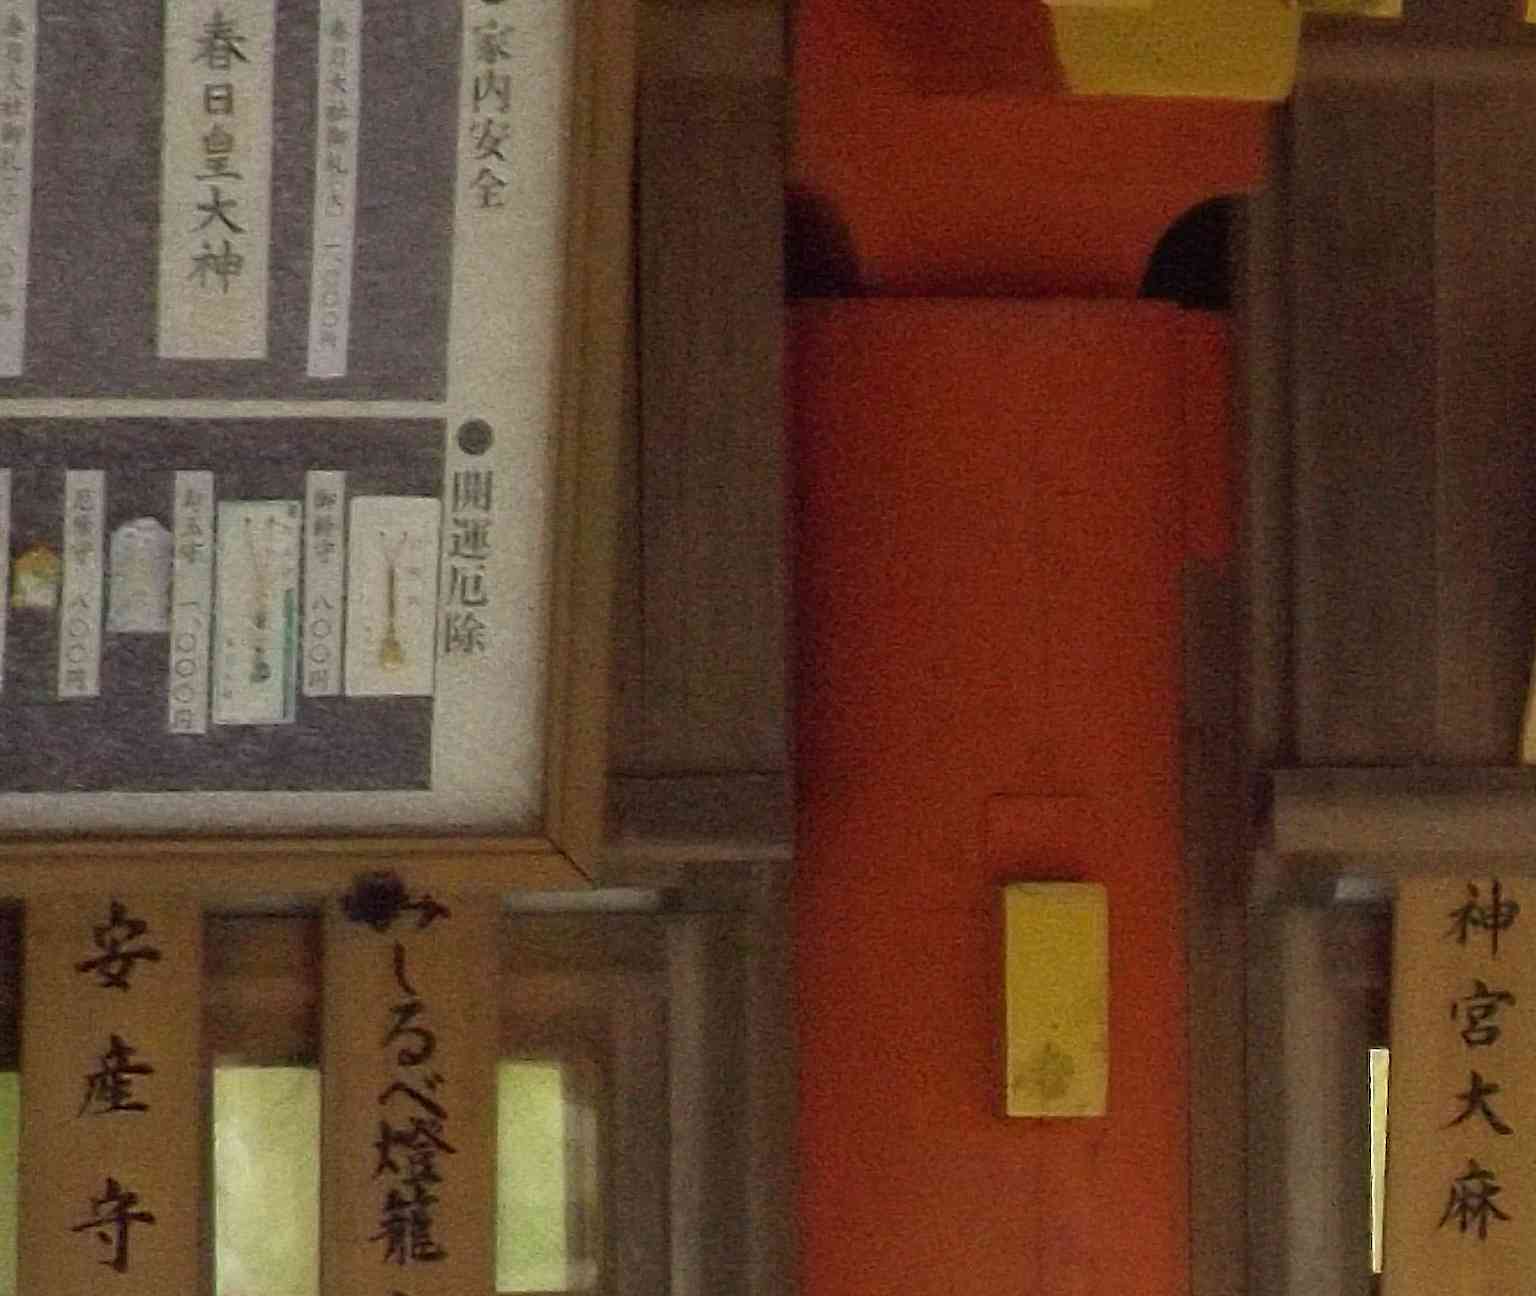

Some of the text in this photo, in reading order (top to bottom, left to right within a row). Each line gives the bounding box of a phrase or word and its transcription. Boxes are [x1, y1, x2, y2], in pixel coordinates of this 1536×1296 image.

[192, 9, 250, 294] 春日皇大神
[470, 20, 512, 209] 家内安全
[444, 470, 494, 654] 開運厄除
[72, 900, 161, 1273] 安産守
[1438, 880, 1519, 1241] 神宮大麻
